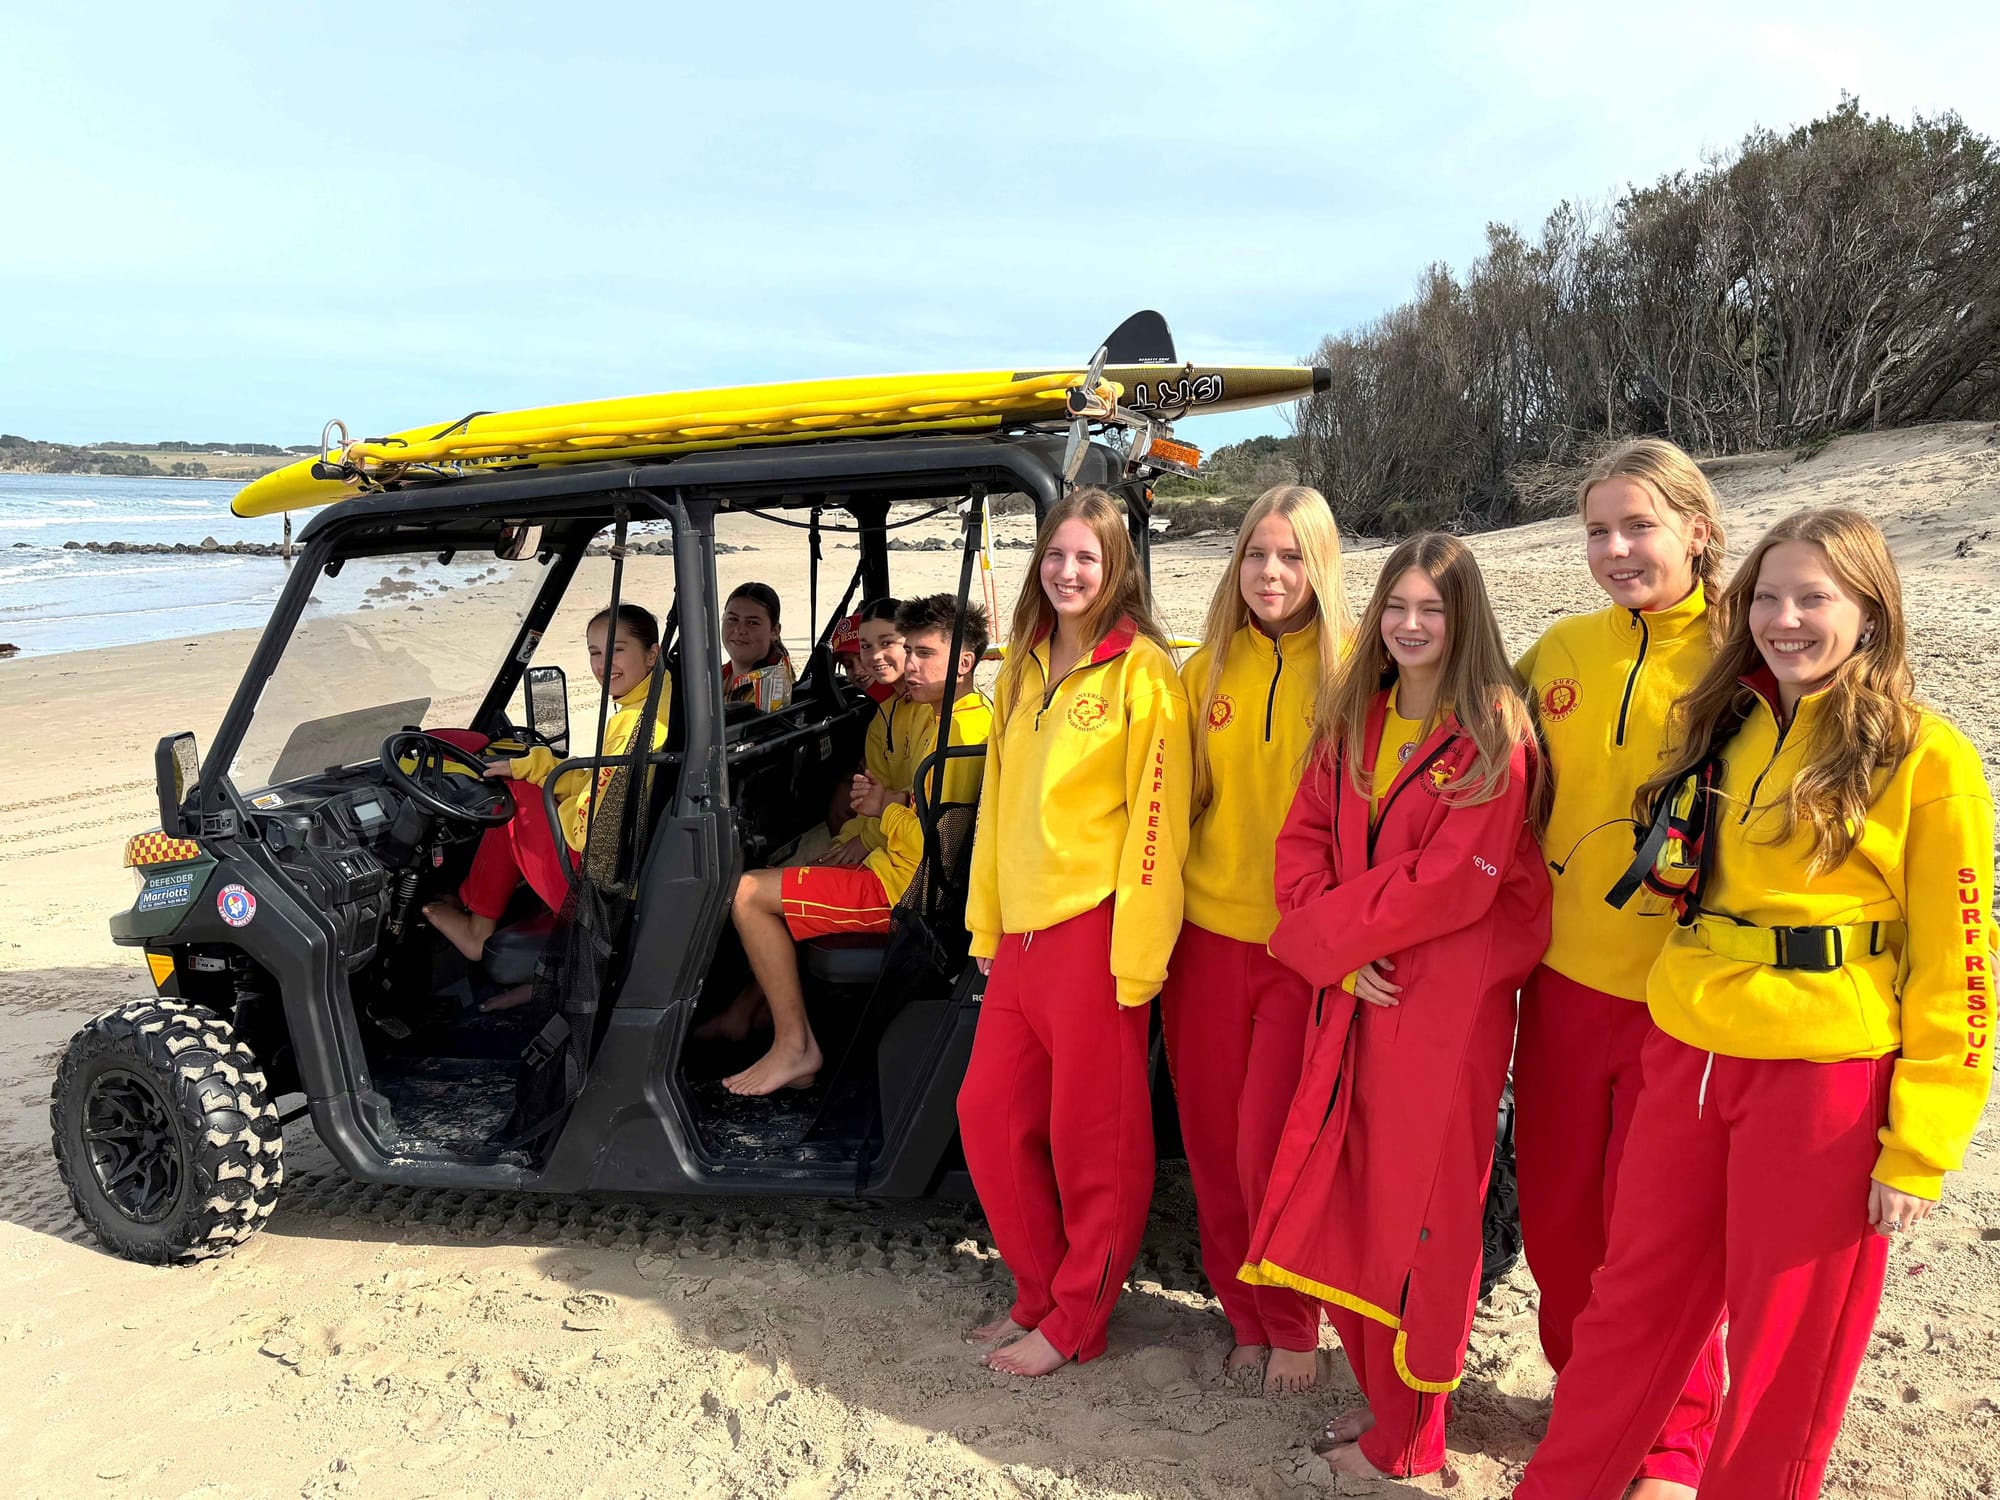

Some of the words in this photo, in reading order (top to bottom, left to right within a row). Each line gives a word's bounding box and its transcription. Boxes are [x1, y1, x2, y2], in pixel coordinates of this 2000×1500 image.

[1153, 737, 1166, 794] SURF
[1141, 801, 1161, 886] RESCUE
[149, 873, 194, 888] DEFENDER
[1472, 855, 1497, 876] EVO
[143, 888, 188, 903] Marriotts
[1957, 868, 1980, 946] SURF
[233, 906, 255, 927] SAVING
[1962, 955, 1987, 1069] RESCUE
